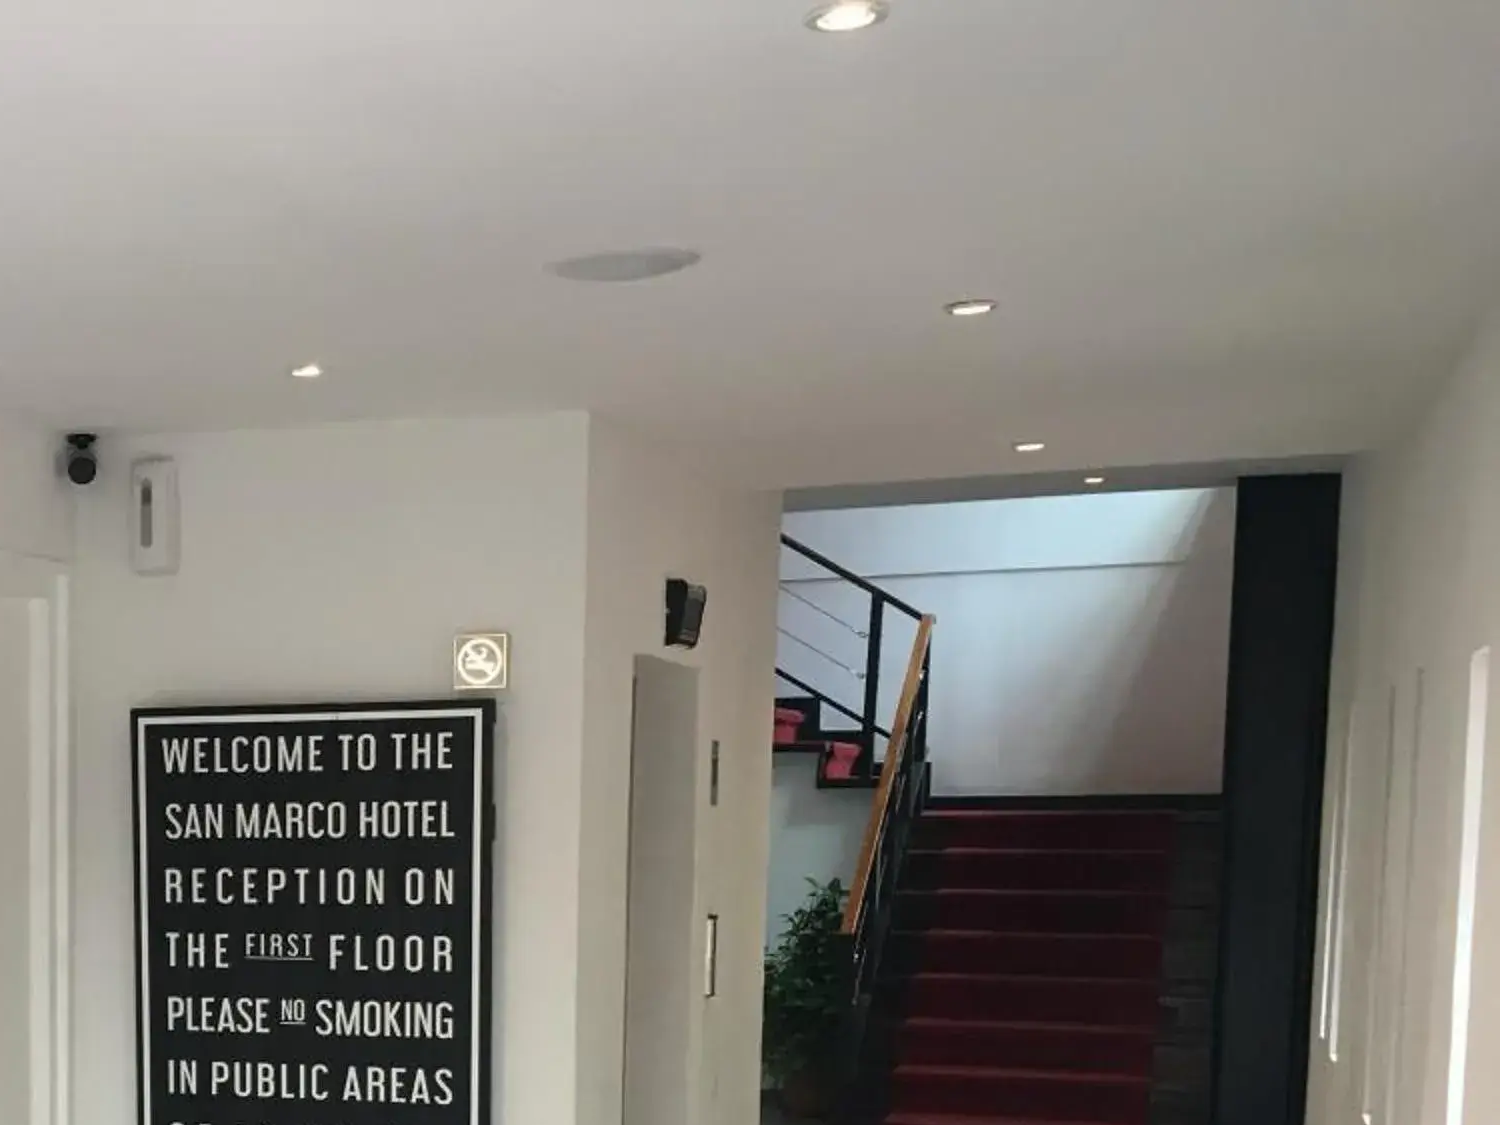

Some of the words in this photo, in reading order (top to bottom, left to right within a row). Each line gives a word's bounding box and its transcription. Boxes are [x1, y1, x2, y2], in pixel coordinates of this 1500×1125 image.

[162, 736, 323, 773] WELCOME
[338, 734, 376, 770] TO
[391, 732, 453, 769] THE
[166, 804, 222, 838] SAN
[236, 802, 346, 838] MARCO
[360, 801, 455, 838] HOTEL
[165, 868, 384, 904] RECEPTION
[406, 868, 453, 905] ON
[166, 932, 228, 968] THE
[246, 934, 312, 960] FIRST
[330, 935, 452, 972] FLOOR
[168, 997, 270, 1033] PLEASE
[280, 999, 305, 1024] NO
[316, 1000, 453, 1038] SMOKING
[168, 1060, 196, 1094] IN
[212, 1062, 328, 1100] PUBLIC
[343, 1066, 452, 1104] AREAS
